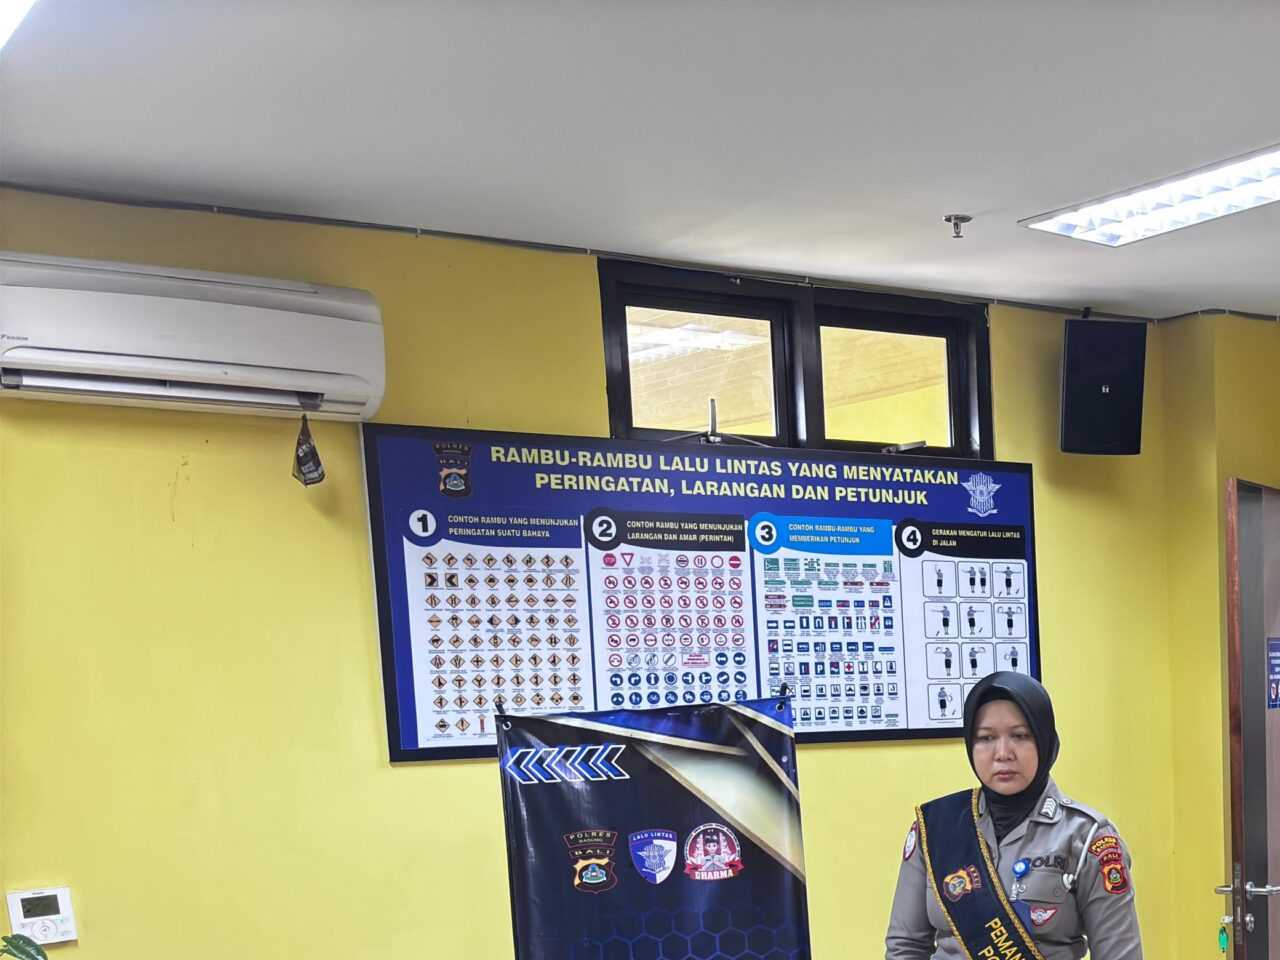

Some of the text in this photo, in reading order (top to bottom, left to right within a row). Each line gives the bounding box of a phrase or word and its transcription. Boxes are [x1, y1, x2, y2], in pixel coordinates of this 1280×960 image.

[490, 446, 958, 485] RAMBU-RAMBU LALU LINTAS YANG MENYATAKAN
[535, 472, 928, 505] PERINGATAN, LARANGAN DAN PETUNJUK
[416, 514, 429, 533] 1
[448, 515, 578, 527] CONTOH RAMBU YANG MENUNJUKAN
[627, 520, 743, 531] CONTOH RAMBU YANG MENUNJUKAN
[788, 523, 814, 531] CONTOH
[449, 528, 550, 538] PERINGATAN SUATU BAHAYA
[598, 519, 613, 538] 2
[760, 524, 774, 542] 3
[627, 533, 735, 543] LARANGAN DAN AMAR (PERINTAH)
[906, 529, 919, 546] 4
[569, 831, 612, 840] POLRES
[694, 869, 734, 880] DHARMA
